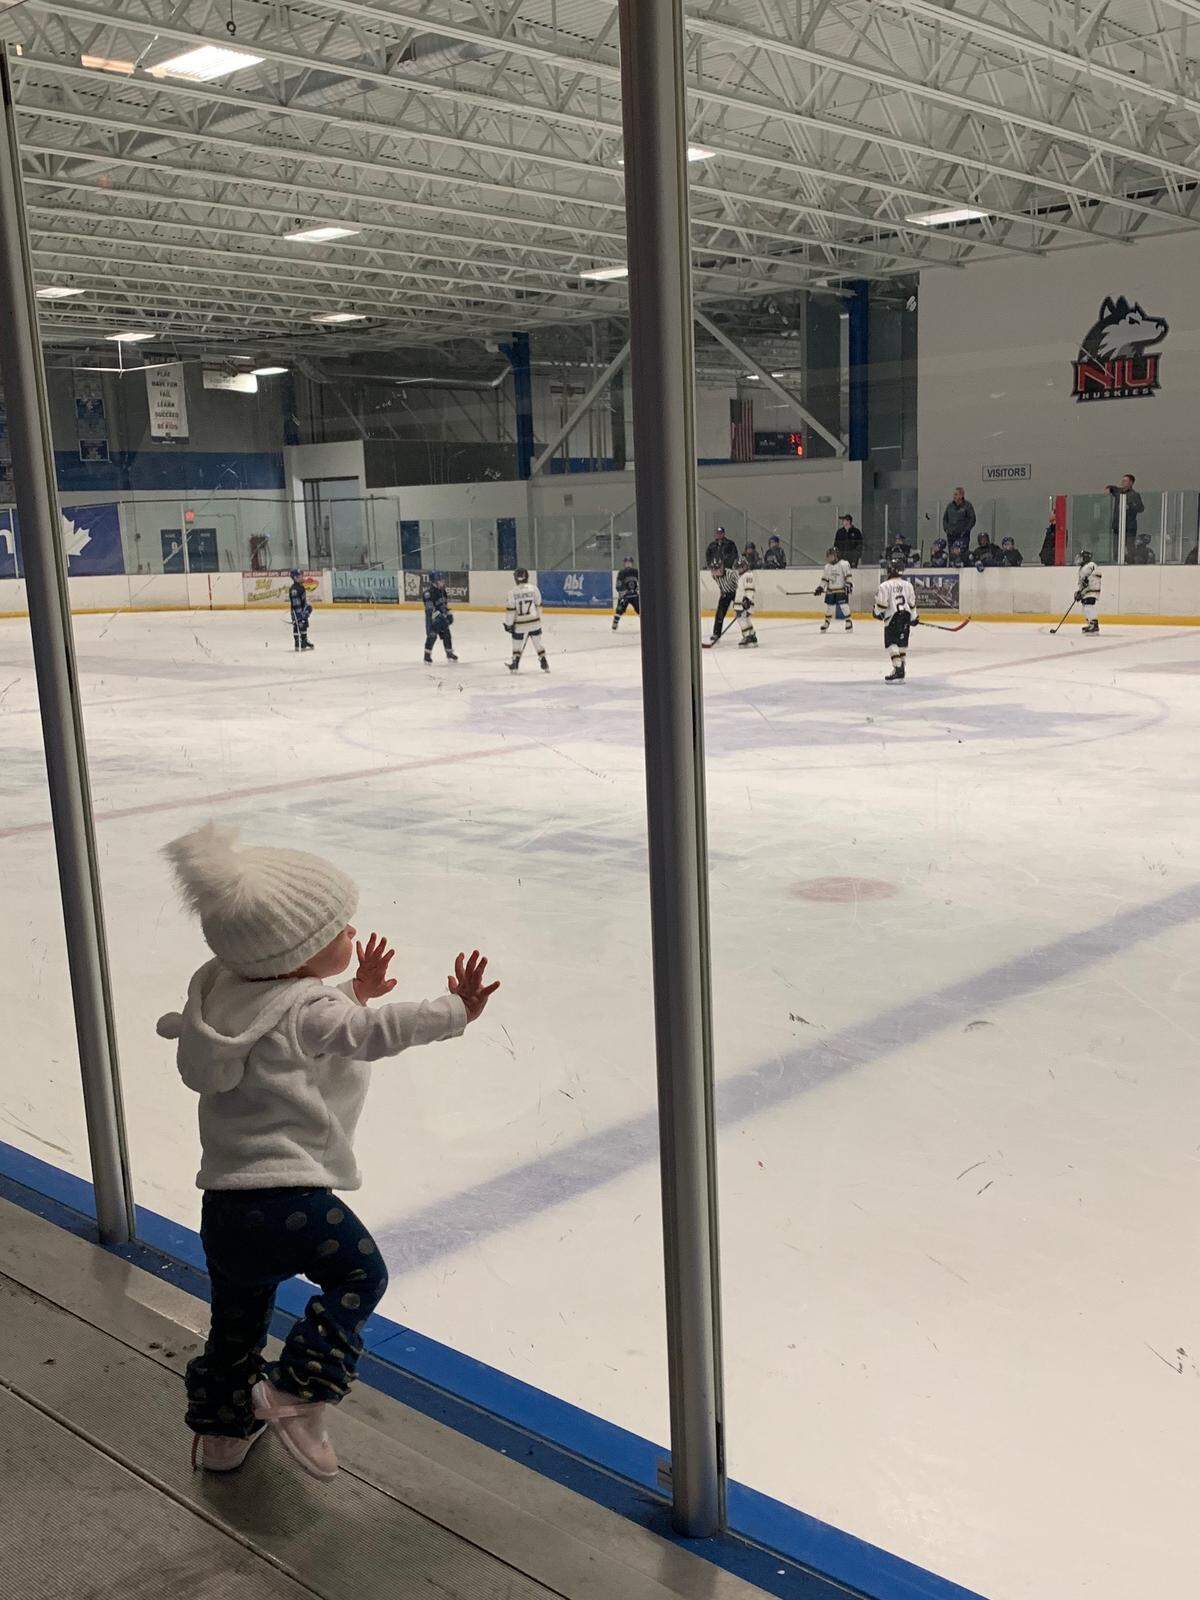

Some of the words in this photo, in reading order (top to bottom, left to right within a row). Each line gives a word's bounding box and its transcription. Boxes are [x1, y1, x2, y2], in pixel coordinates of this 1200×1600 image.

[1077, 356, 1155, 392] NIU
[1082, 388, 1150, 400] HUSKIES
[987, 466, 1026, 478] VISITORS
[563, 573, 585, 590] Abt
[517, 600, 533, 617] 17
[895, 595, 906, 613] 2
